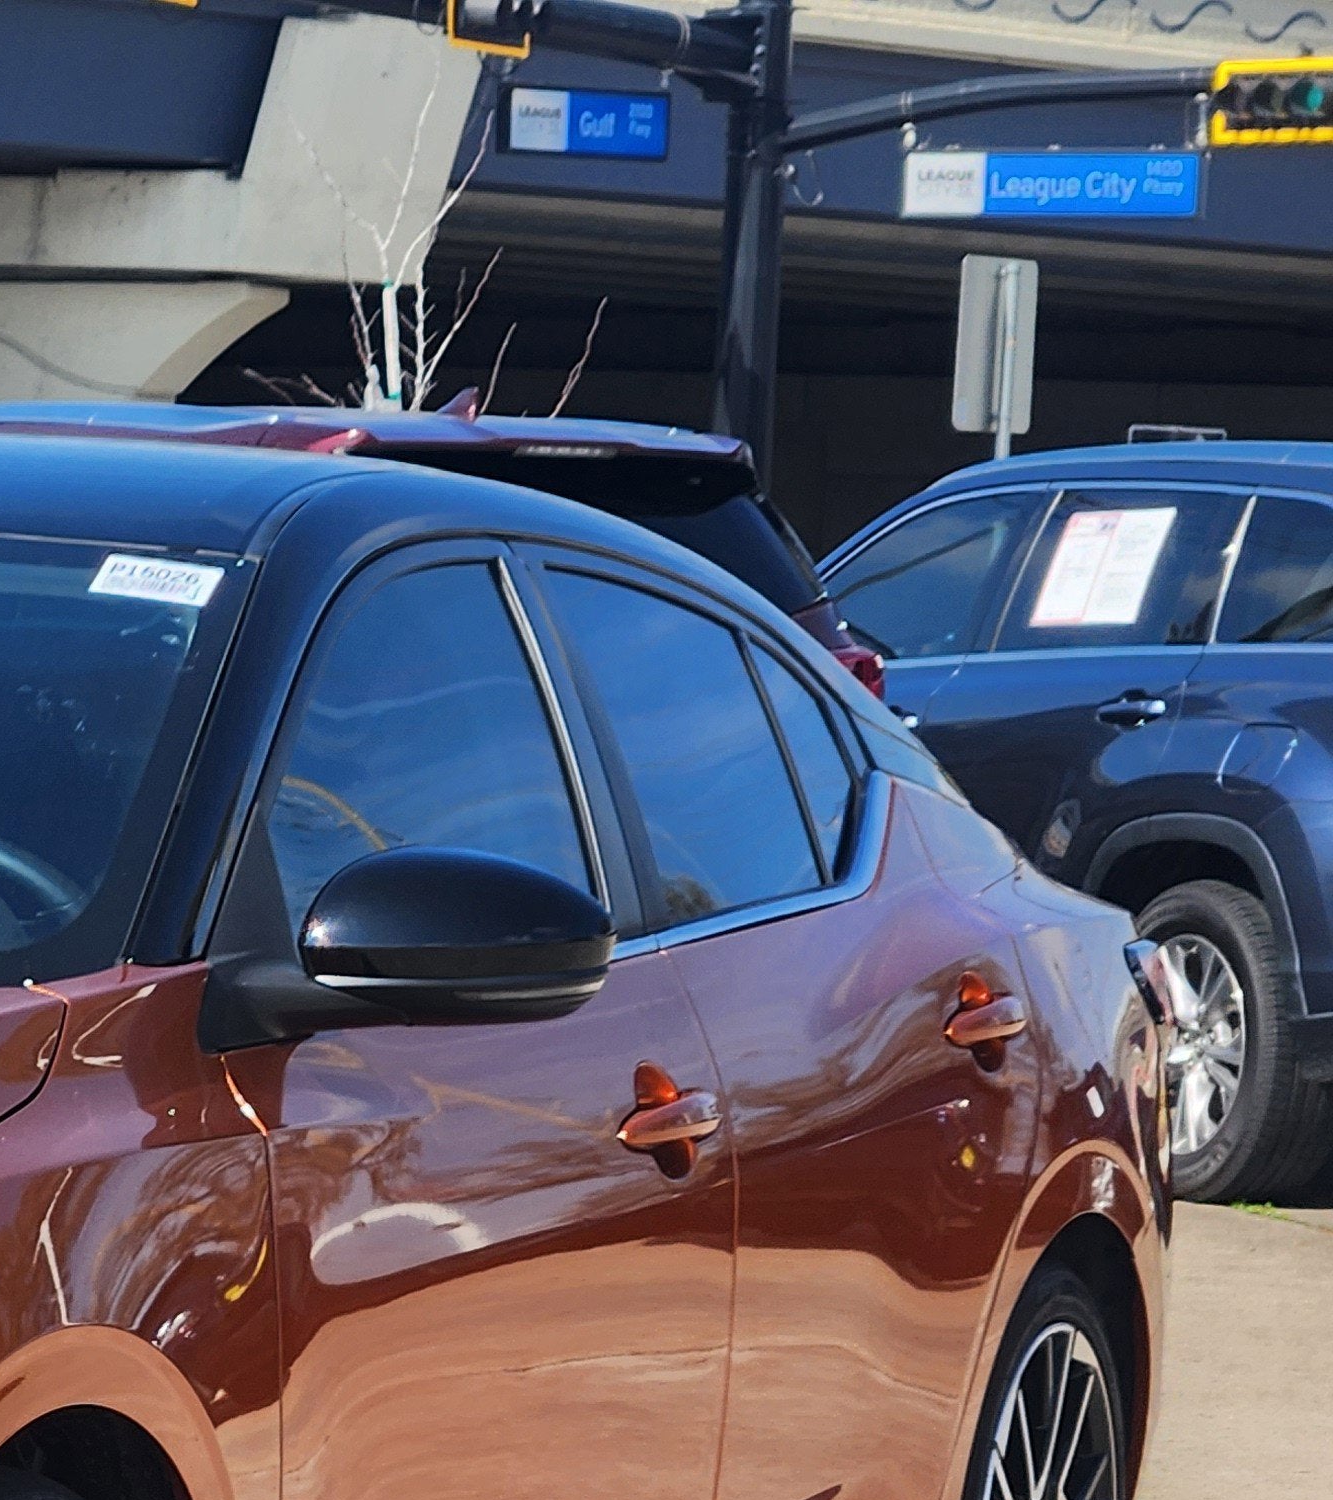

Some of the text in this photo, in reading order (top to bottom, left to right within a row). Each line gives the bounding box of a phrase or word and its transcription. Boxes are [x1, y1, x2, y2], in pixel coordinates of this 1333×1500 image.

[579, 110, 616, 138] Gulf
[989, 170, 1136, 206] League City
